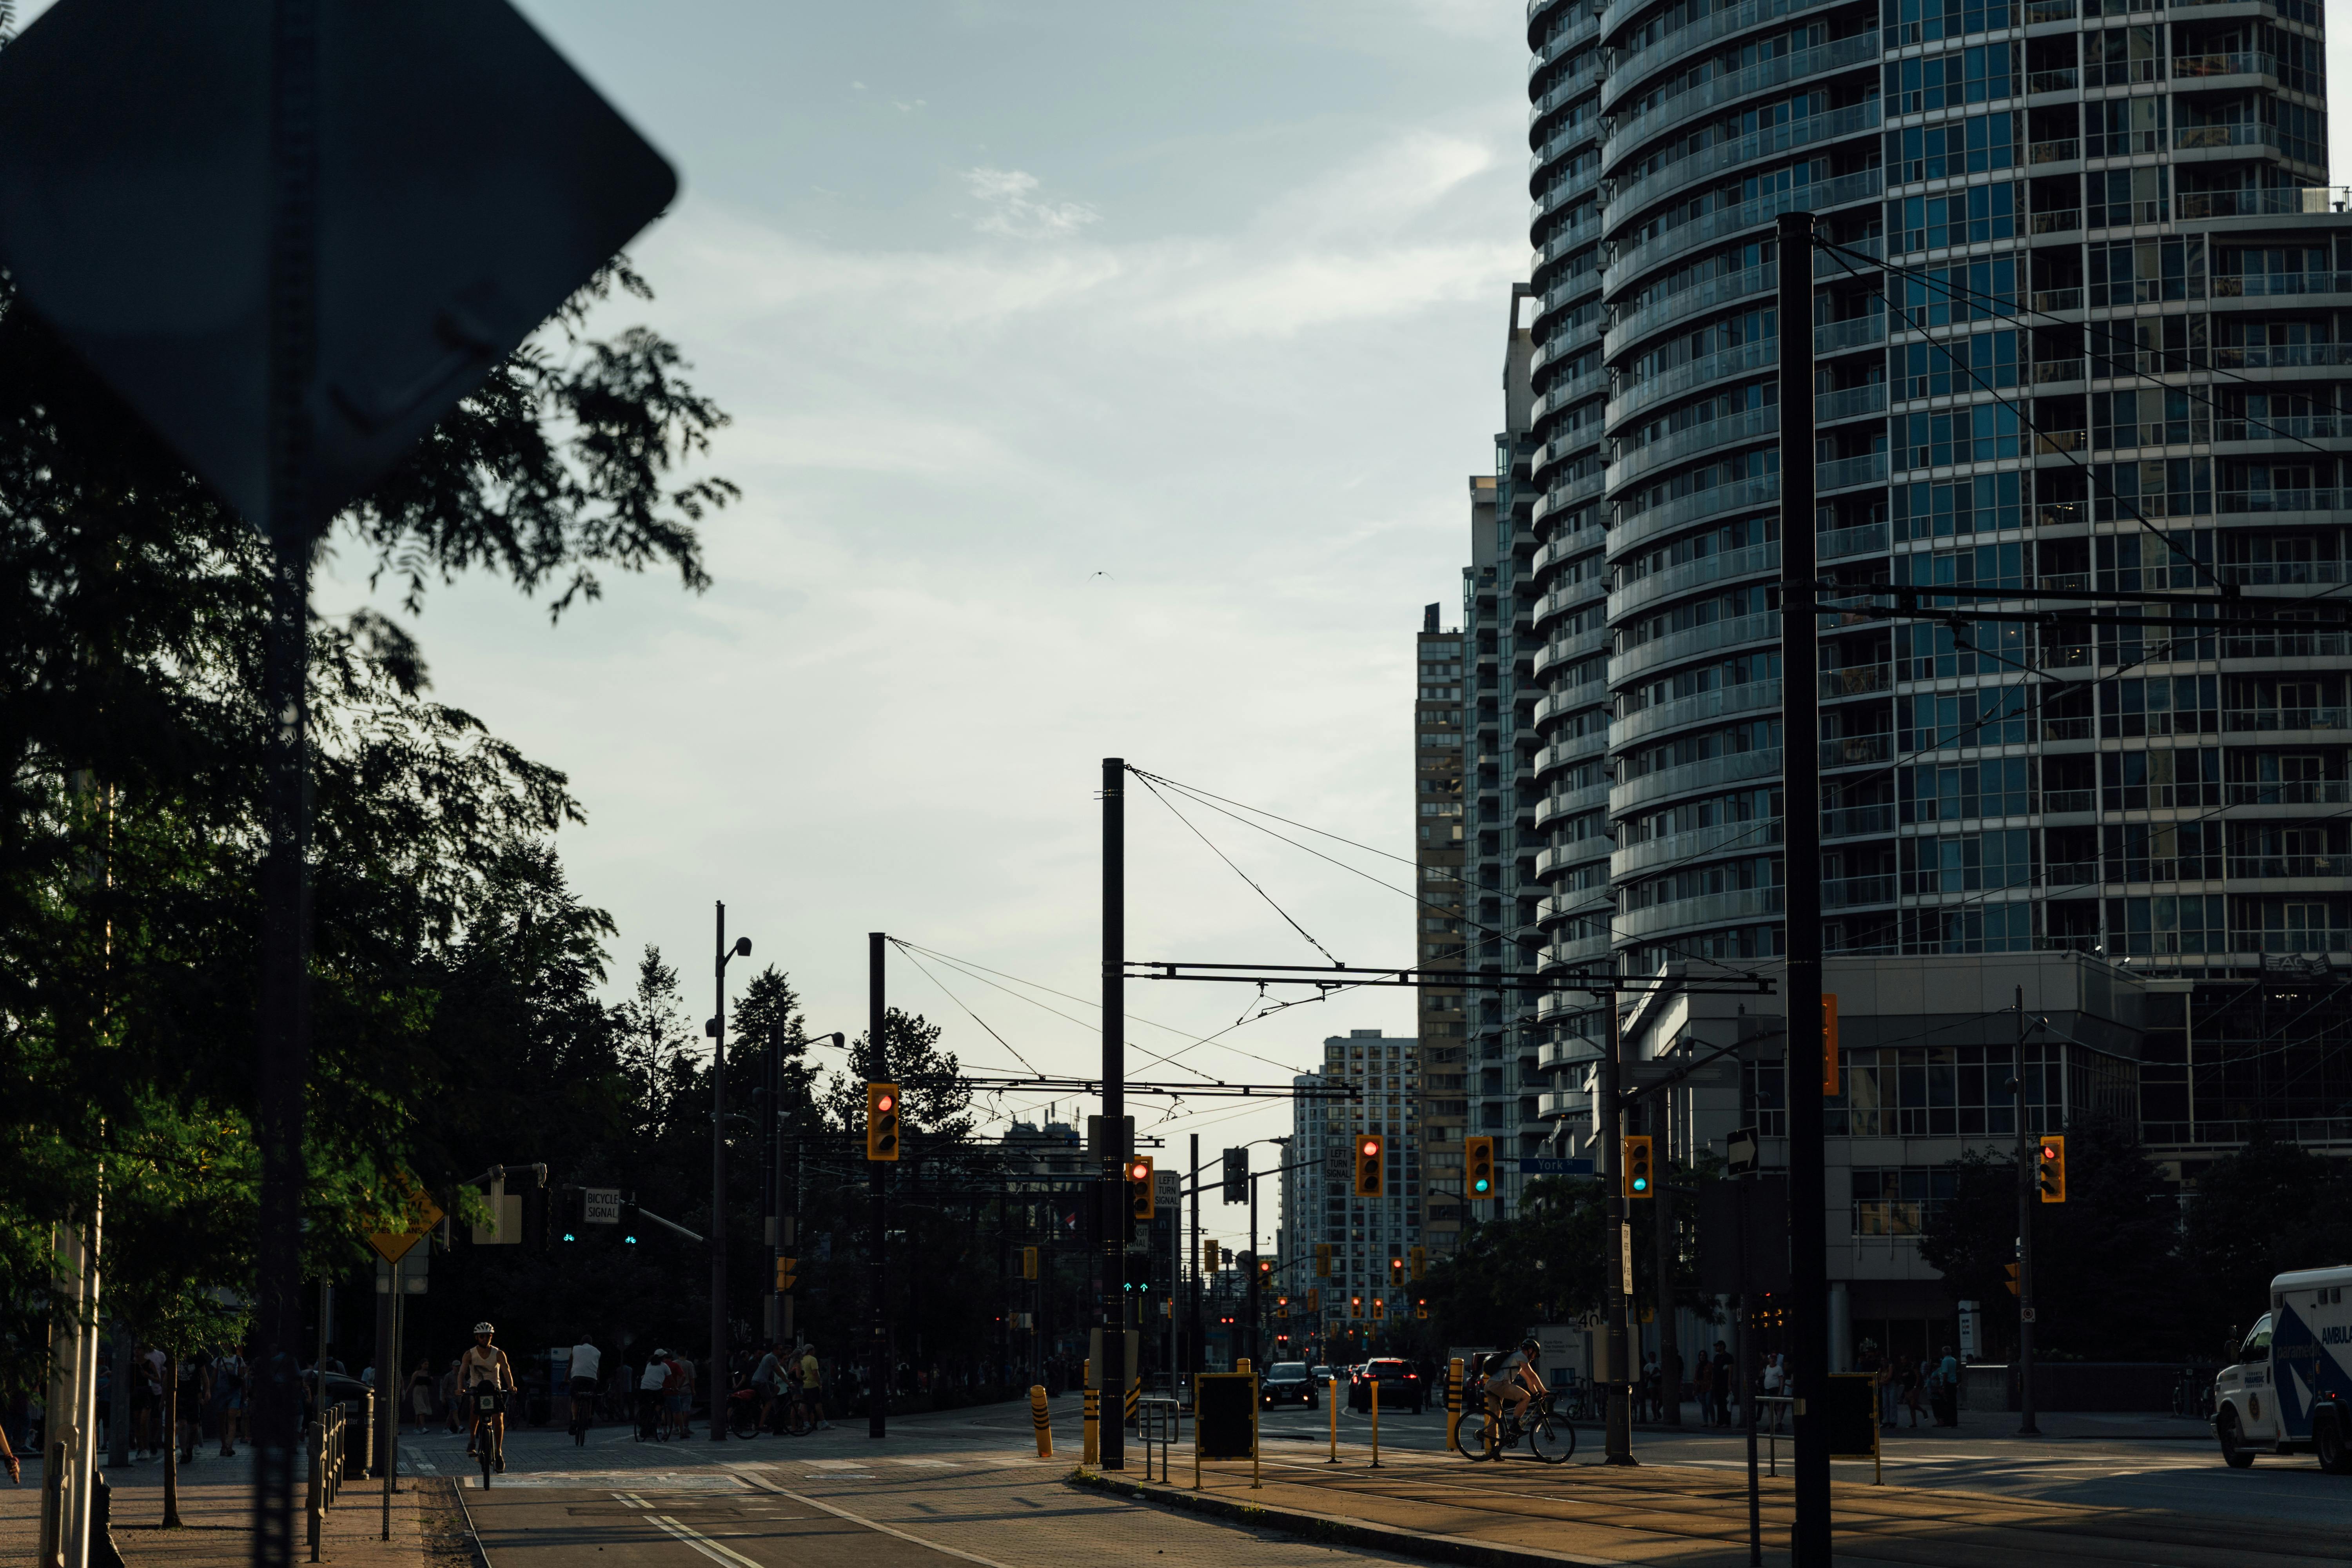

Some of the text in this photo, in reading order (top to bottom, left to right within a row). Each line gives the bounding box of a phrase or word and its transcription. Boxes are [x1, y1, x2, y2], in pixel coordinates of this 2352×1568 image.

[1331, 1149, 1347, 1158] LEFT
[1330, 1159, 1347, 1167] TURN
[1538, 1160, 1563, 1170] York
[1327, 1169, 1350, 1178] SIGNAL
[1159, 1176, 1175, 1185] LEFT
[1158, 1186, 1176, 1194] TURN
[588, 1193, 618, 1204] BICYCLE
[1155, 1196, 1178, 1205] SIGNAL
[588, 1207, 616, 1218] SIGNAL
[1578, 1314, 1599, 1328] 40
[2276, 1339, 2321, 1364] paramedic
